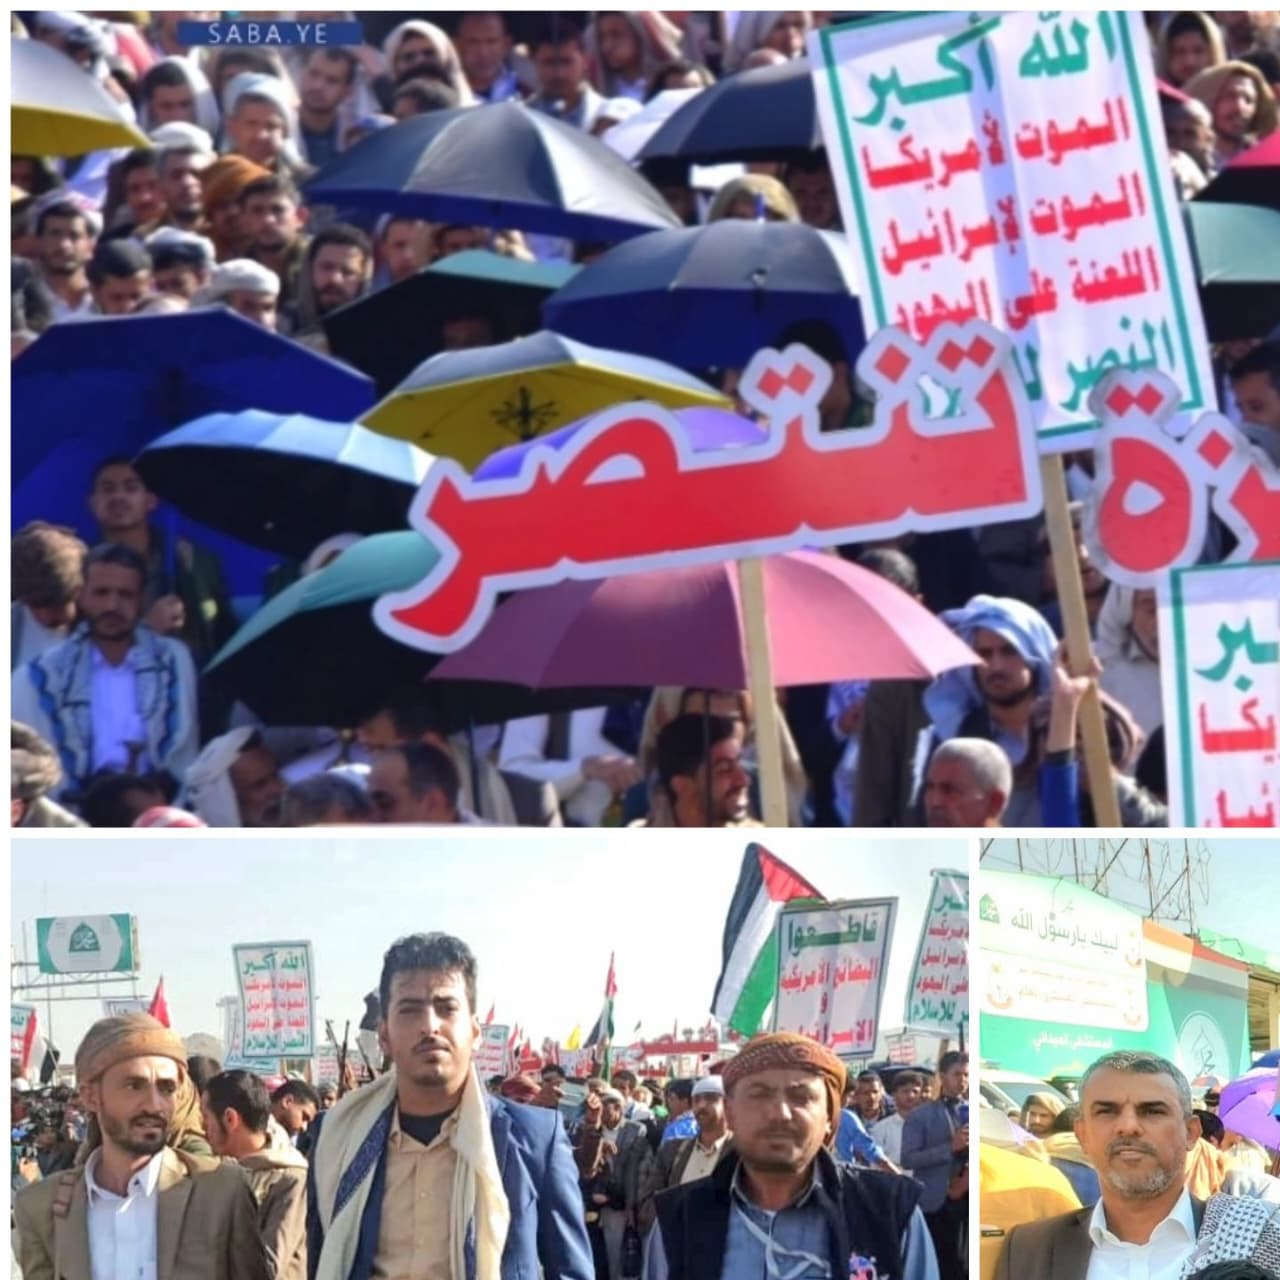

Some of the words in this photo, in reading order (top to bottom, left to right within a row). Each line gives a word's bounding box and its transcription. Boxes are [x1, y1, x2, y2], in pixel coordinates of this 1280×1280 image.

[852, 13, 1001, 131] أكبر
[1015, 96, 1130, 166] الموت
[1030, 172, 1146, 241] الموت
[1006, 269, 1059, 331] على
[1070, 246, 1160, 304] اللعنة
[384, 330, 1036, 645] تنتصر
[788, 911, 880, 957] قاطعوا
[1011, 908, 1033, 931] الله
